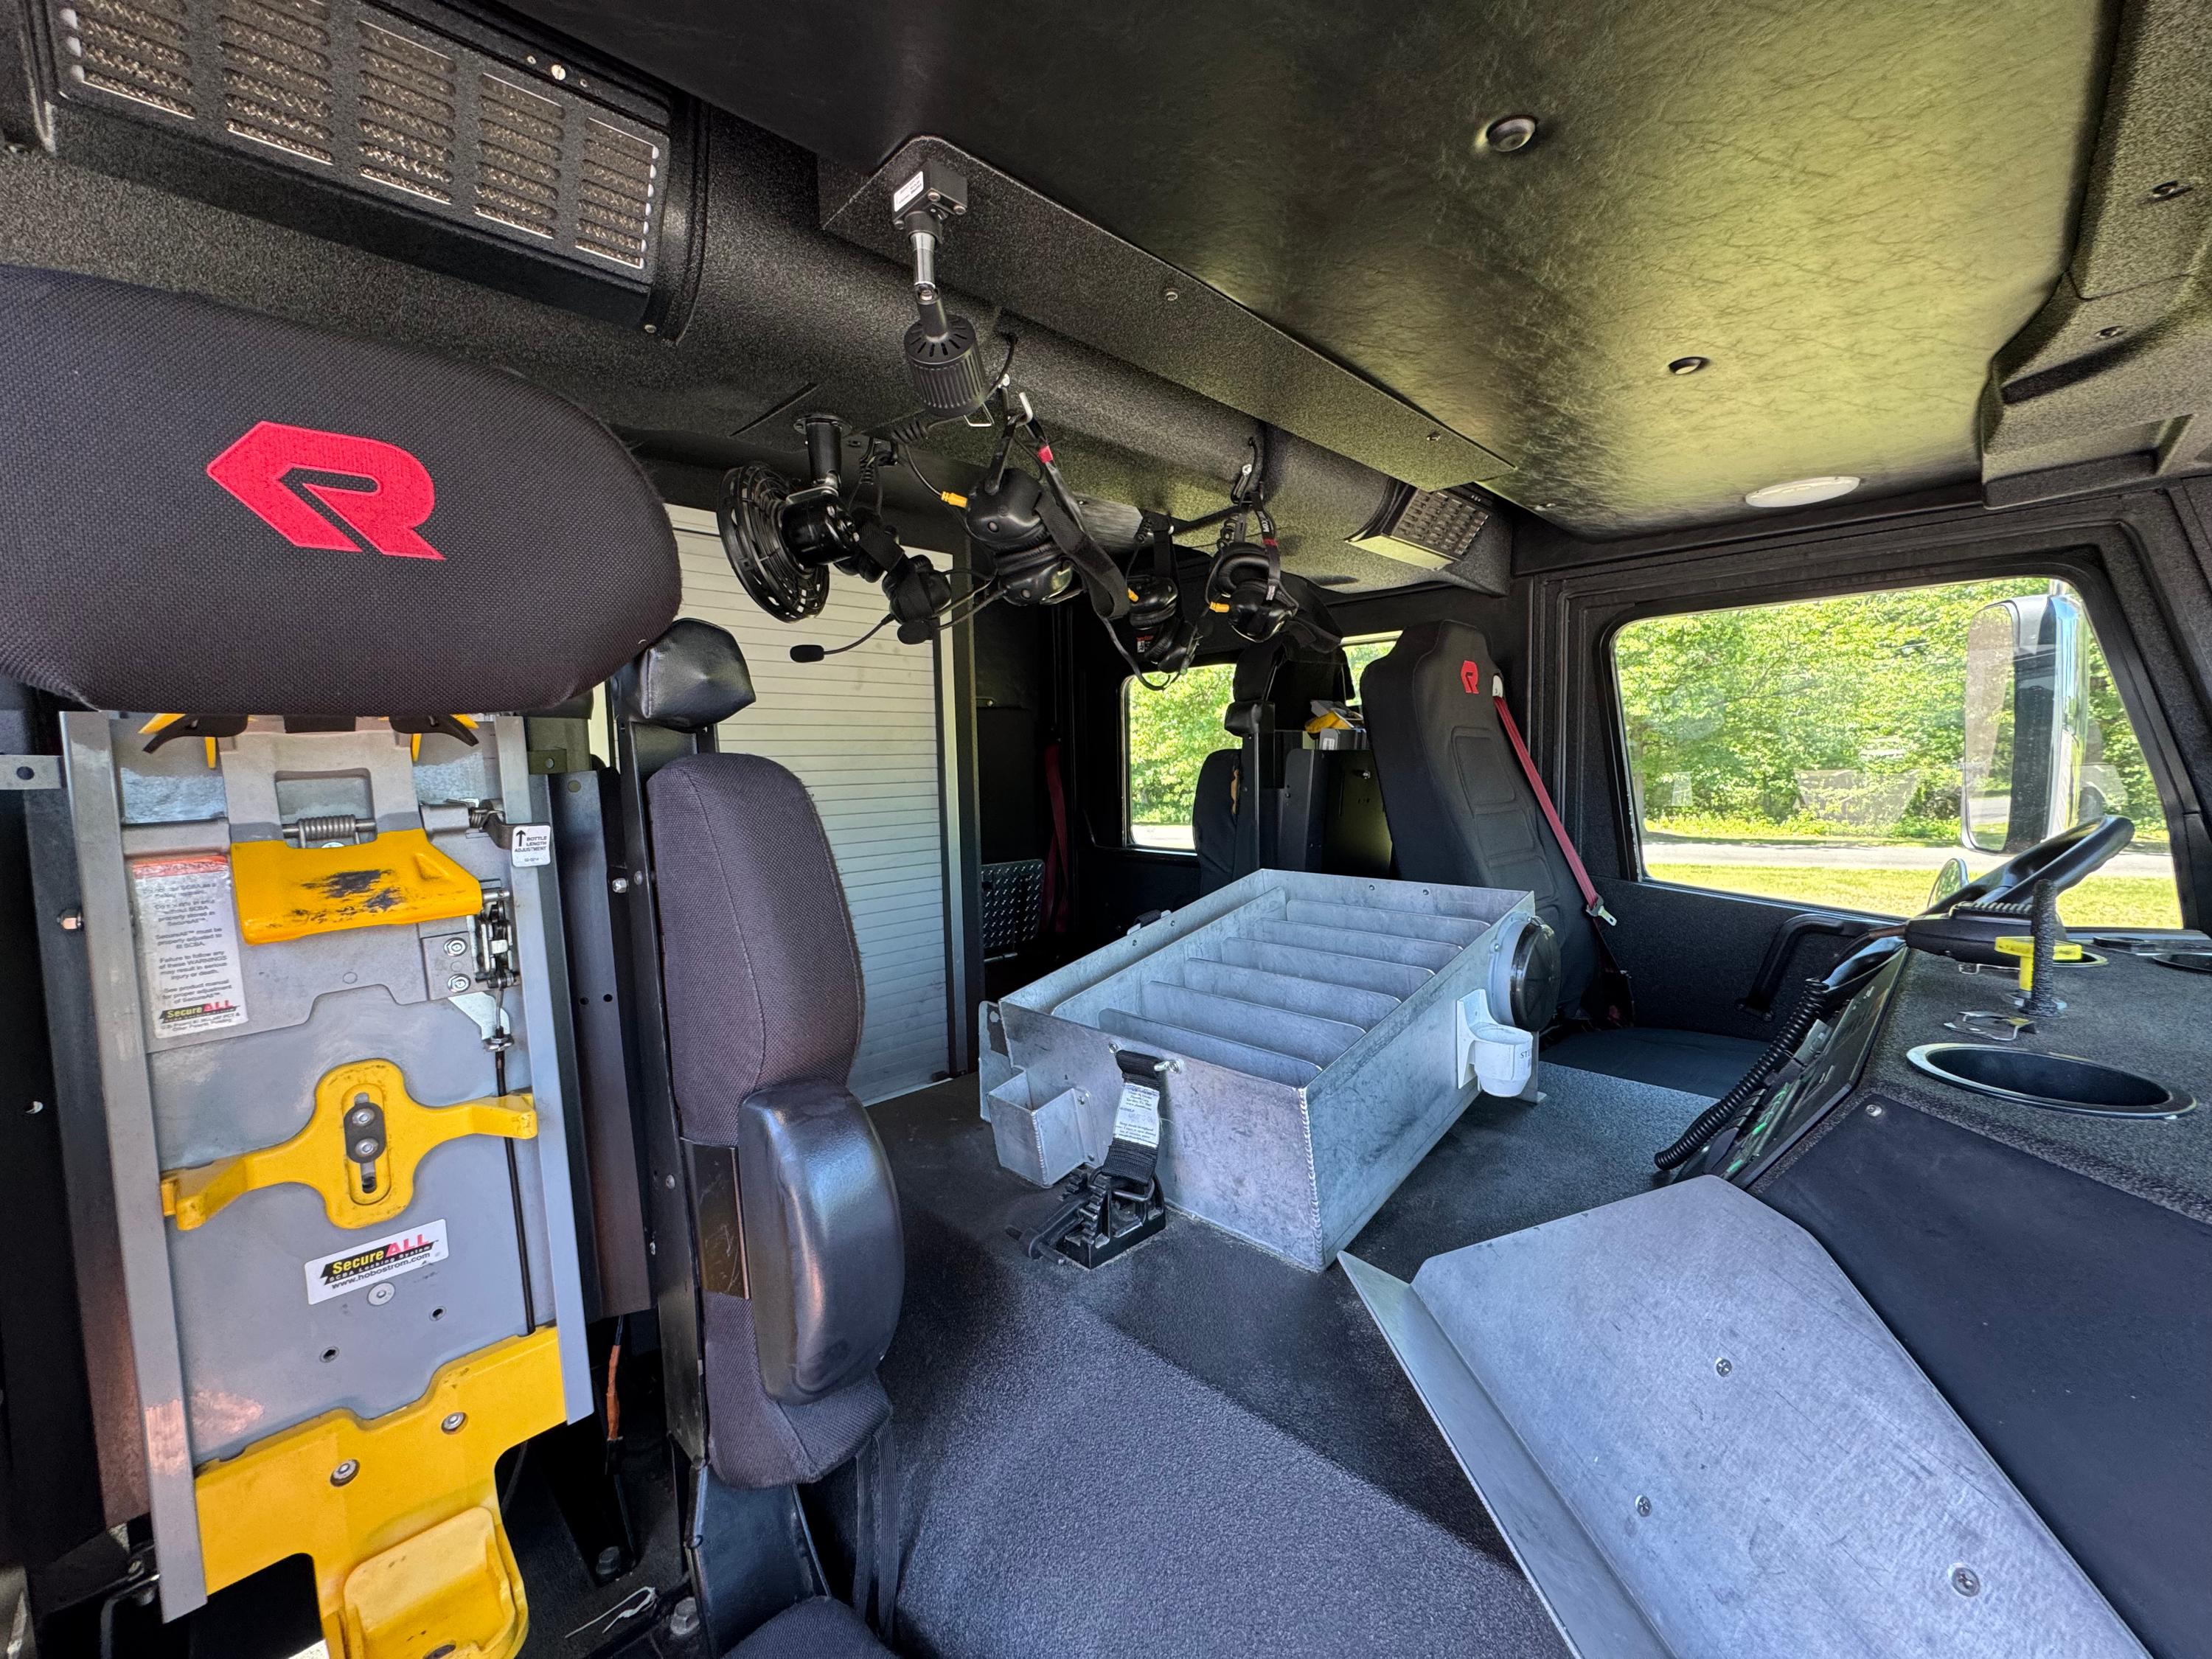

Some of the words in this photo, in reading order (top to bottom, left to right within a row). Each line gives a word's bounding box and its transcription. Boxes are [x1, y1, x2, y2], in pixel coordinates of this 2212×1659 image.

[206, 420, 446, 560] R
[1461, 660, 1479, 695] R
[187, 956, 227, 965] WARNINGS
[197, 985, 232, 994] adjustment
[329, 1270, 355, 1282] SCBA
[358, 1256, 395, 1273] Locking
[398, 1245, 431, 1260] System
[331, 1252, 431, 1290] www.hobostrom.com
